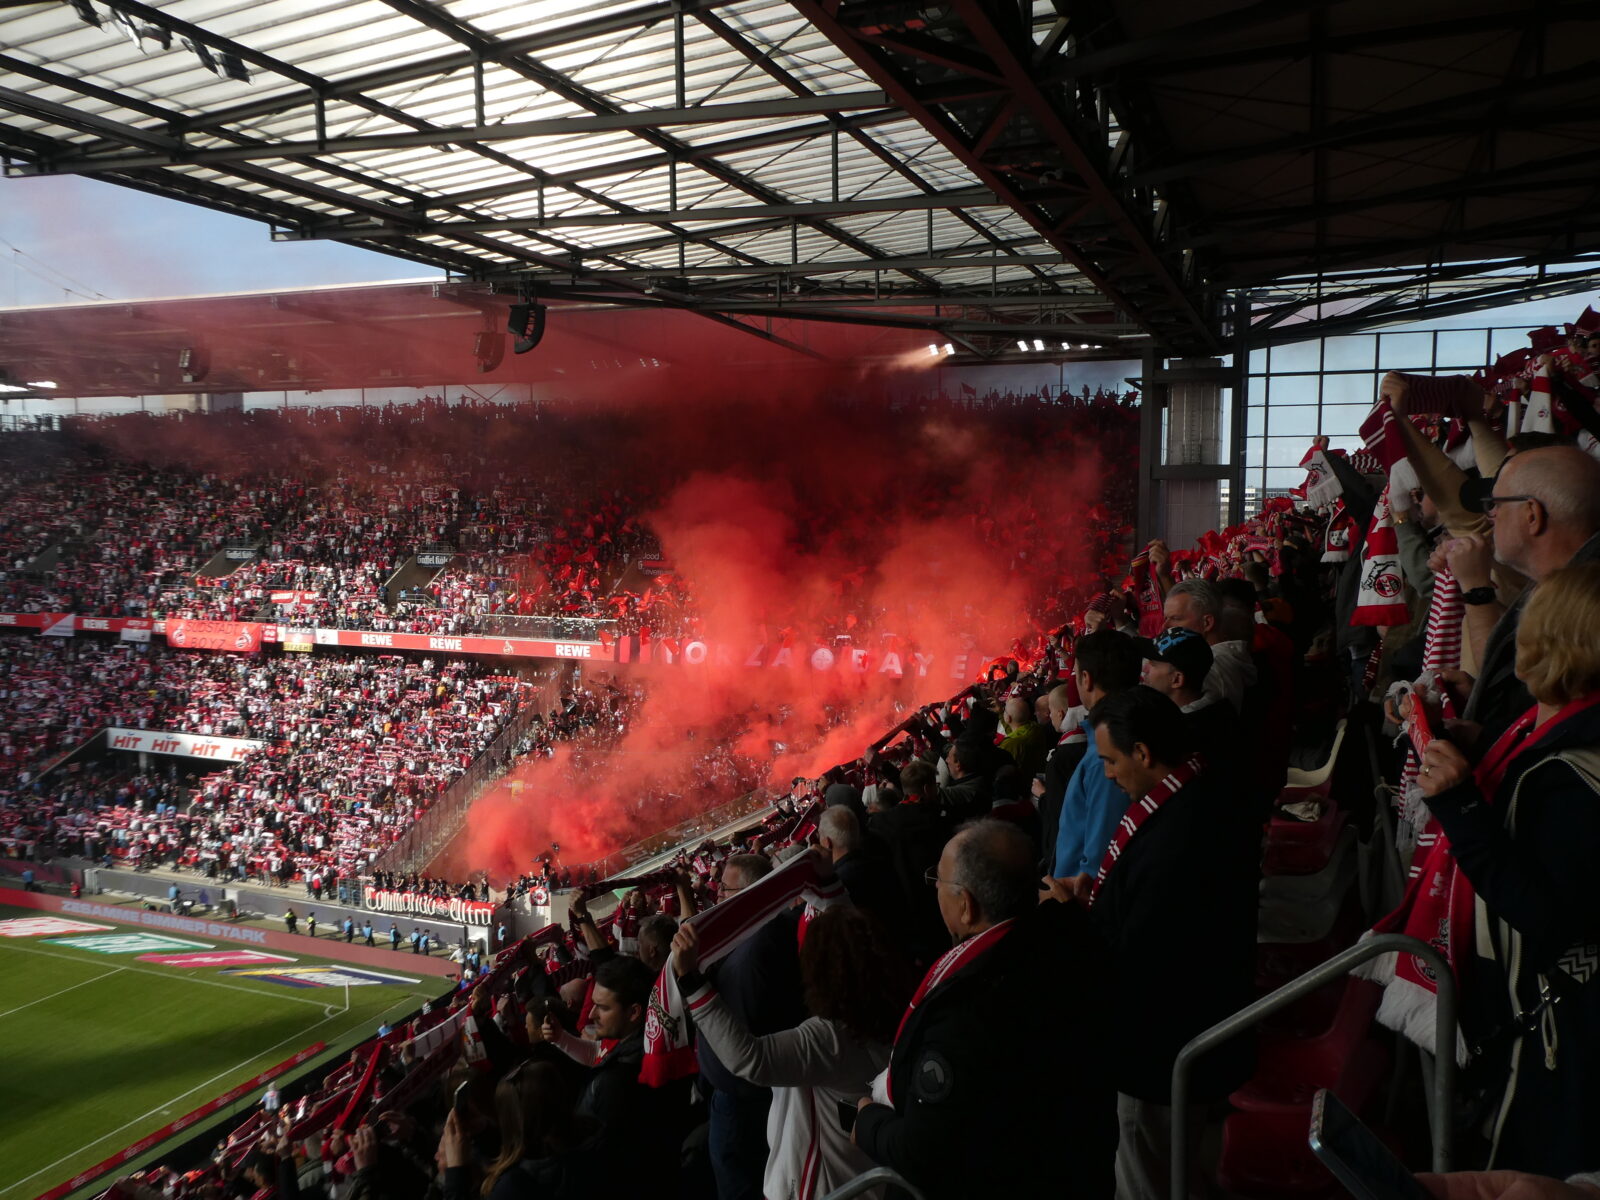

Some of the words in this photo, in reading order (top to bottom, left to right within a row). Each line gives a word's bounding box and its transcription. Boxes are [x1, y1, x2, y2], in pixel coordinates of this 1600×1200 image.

[361, 633, 393, 646] REWE
[429, 637, 463, 651] REWE
[555, 644, 591, 658] REWE
[851, 649, 996, 678] BAYE
[113, 735, 142, 749] HIT
[152, 739, 181, 753] HIT
[190, 743, 221, 757] HIT
[61, 900, 142, 922] ZESAMME
[142, 912, 207, 934] SIMMER
[207, 922, 267, 944] STARK
